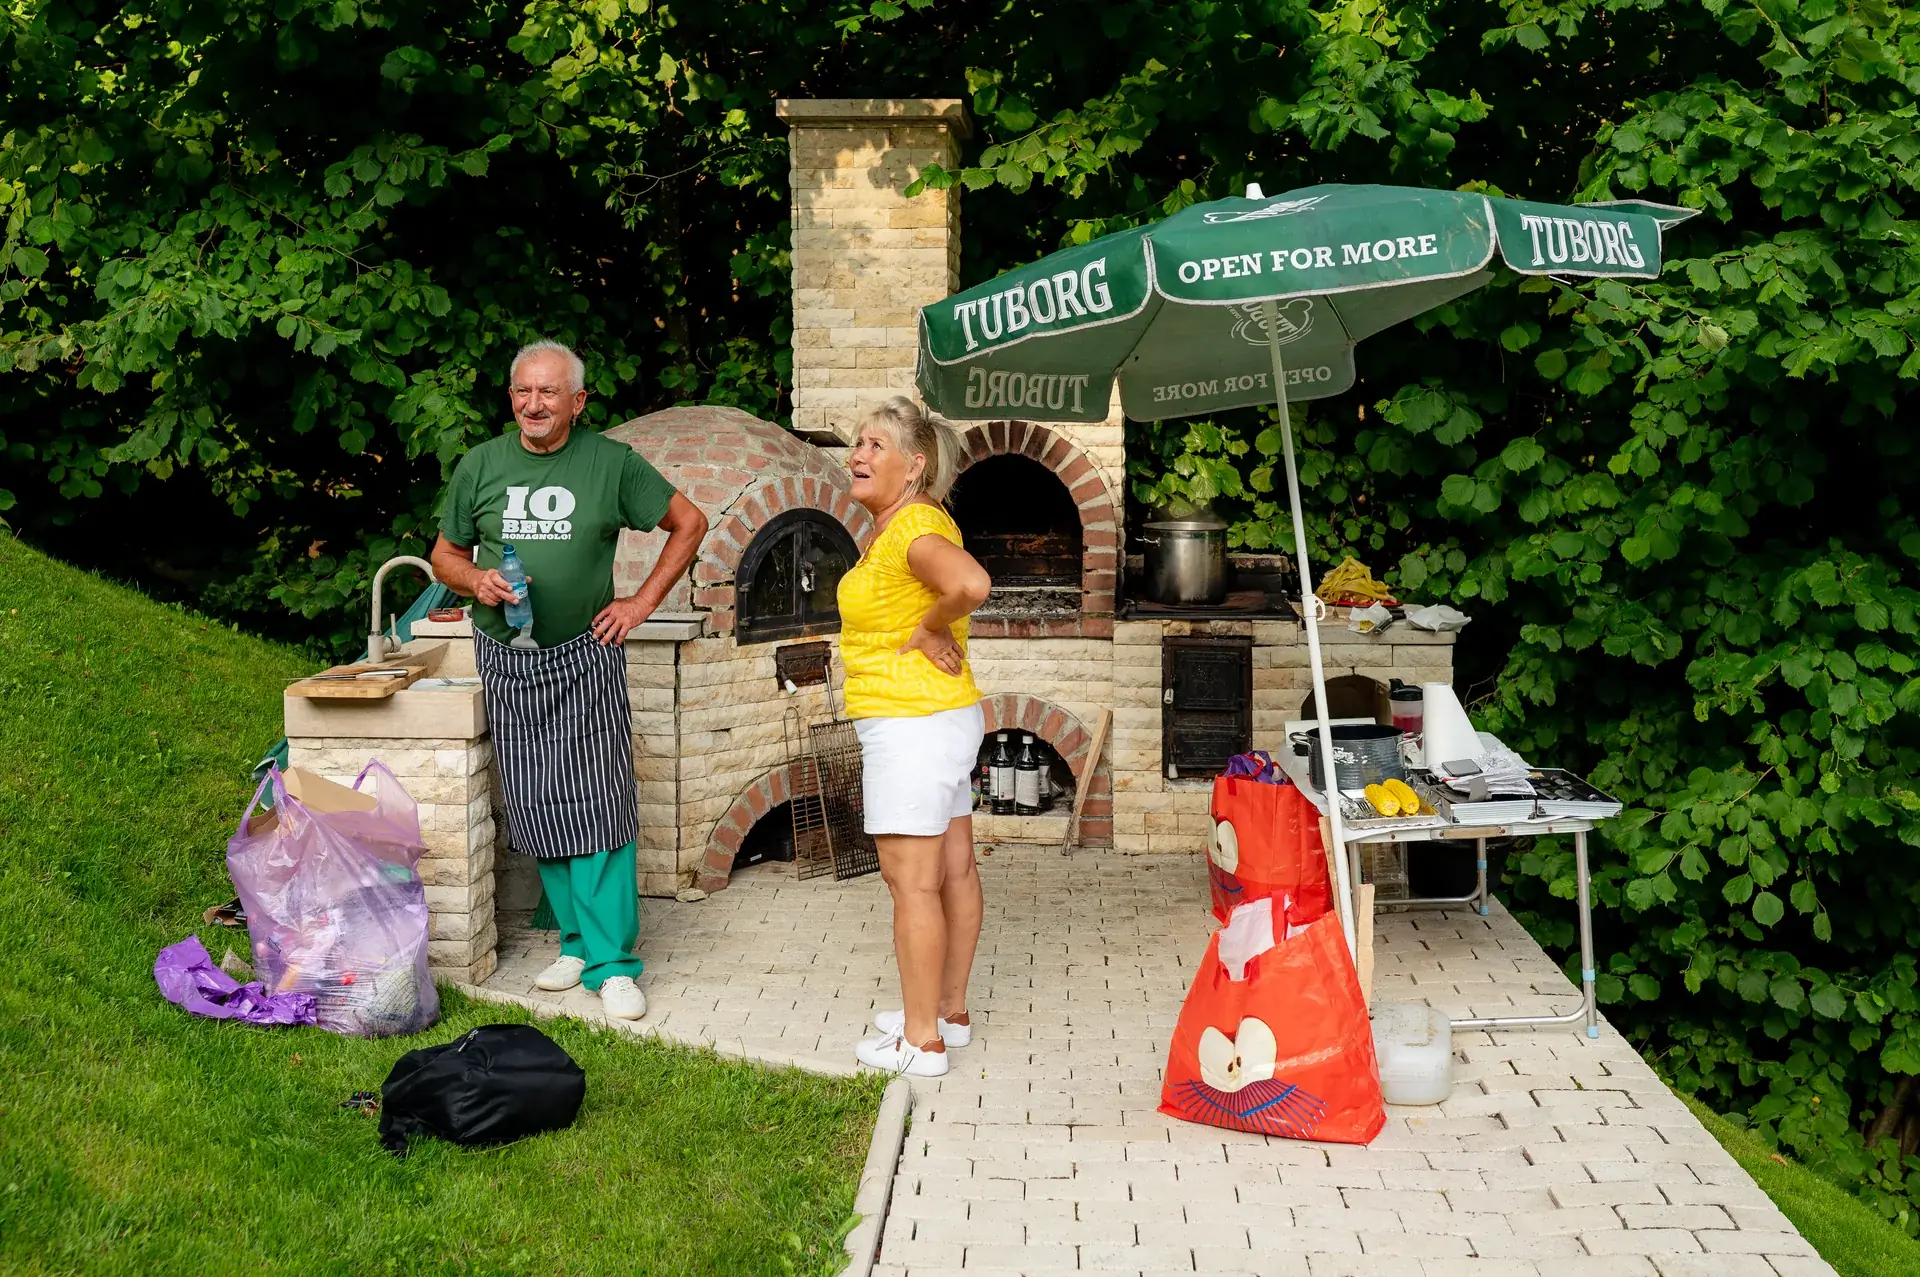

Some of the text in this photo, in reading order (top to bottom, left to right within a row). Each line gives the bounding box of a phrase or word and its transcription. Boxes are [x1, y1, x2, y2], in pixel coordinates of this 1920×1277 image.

[1178, 233, 1438, 284] OPEN FOR MORE
[1520, 213, 1645, 268] TUBORG
[953, 256, 1113, 351] TUBORG
[501, 519, 572, 534] BEVO
[502, 486, 576, 520] IO
